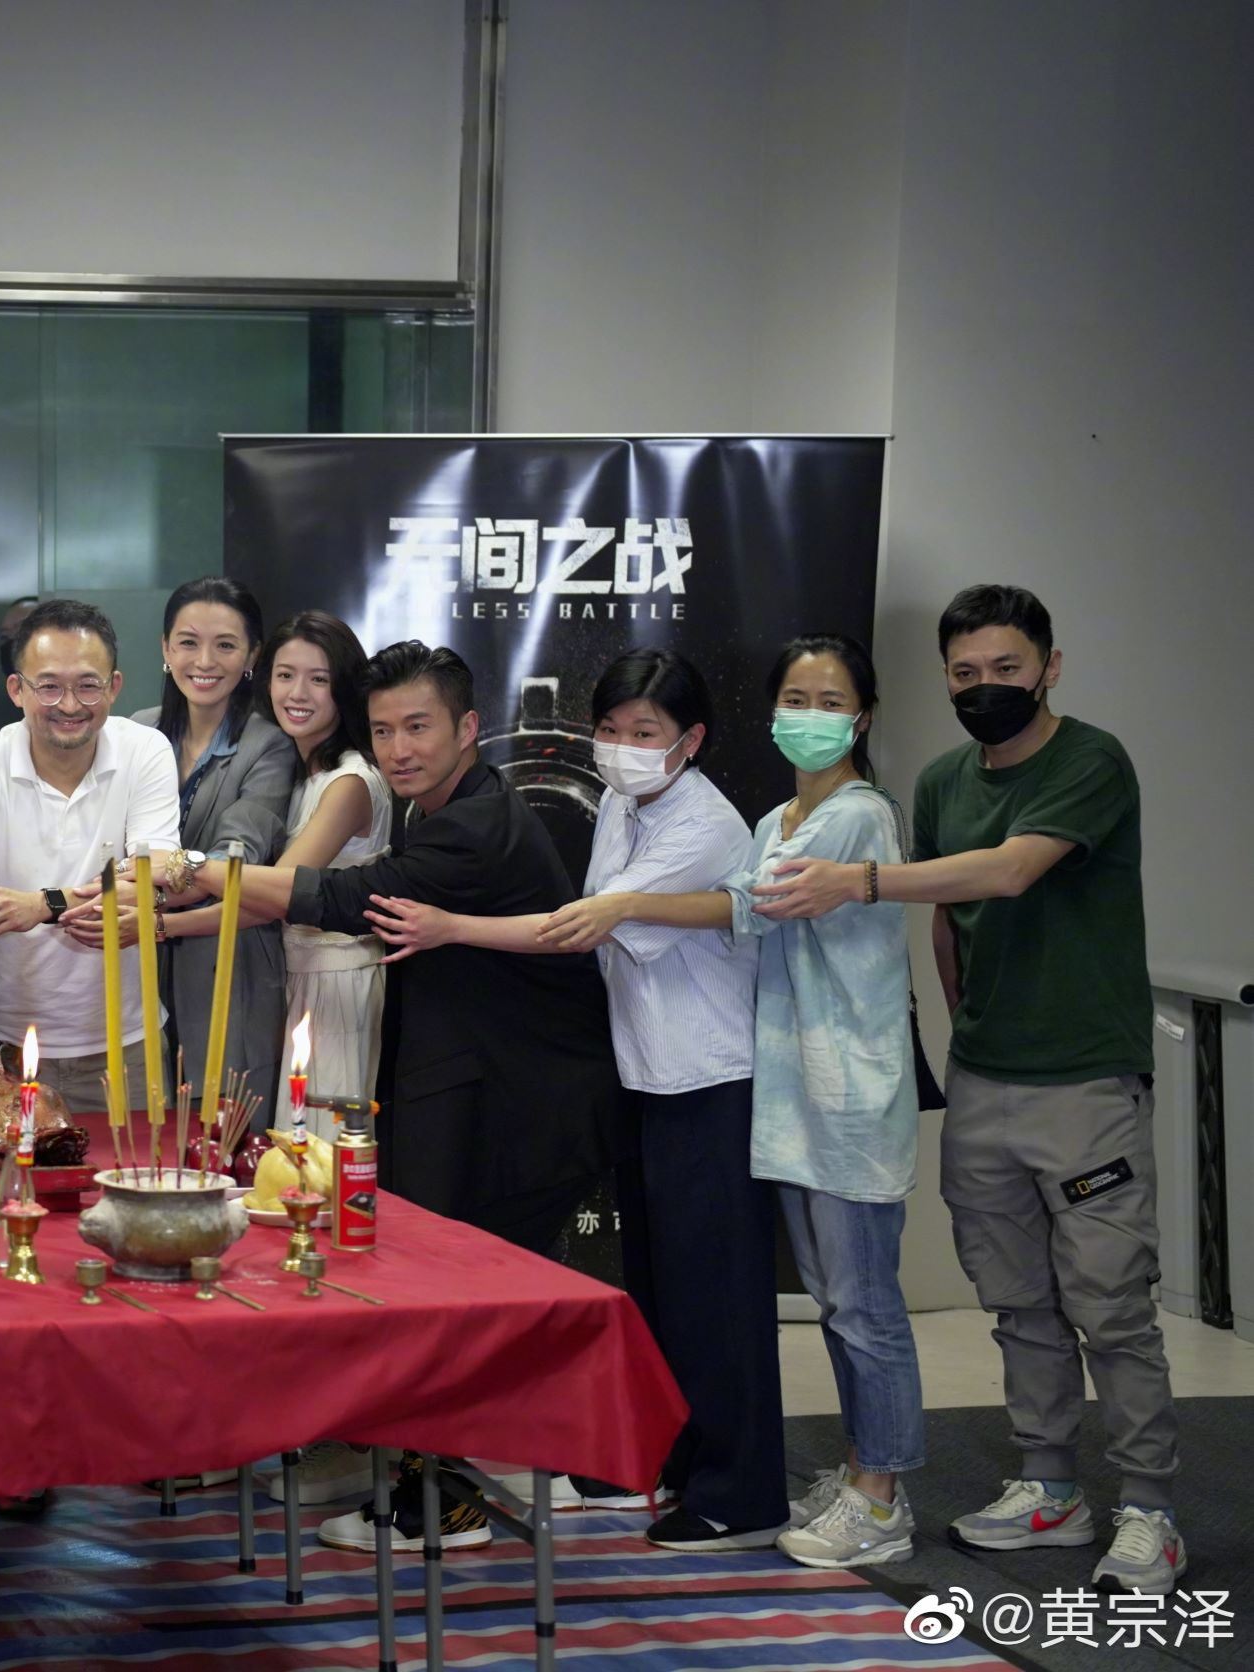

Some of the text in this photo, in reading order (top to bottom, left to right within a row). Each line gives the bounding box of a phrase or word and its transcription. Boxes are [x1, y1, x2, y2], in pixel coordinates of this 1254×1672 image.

[385, 517, 693, 594] 无间之战
[414, 602, 685, 620] LESS BATTLE
[577, 1210, 620, 1235] 亦
